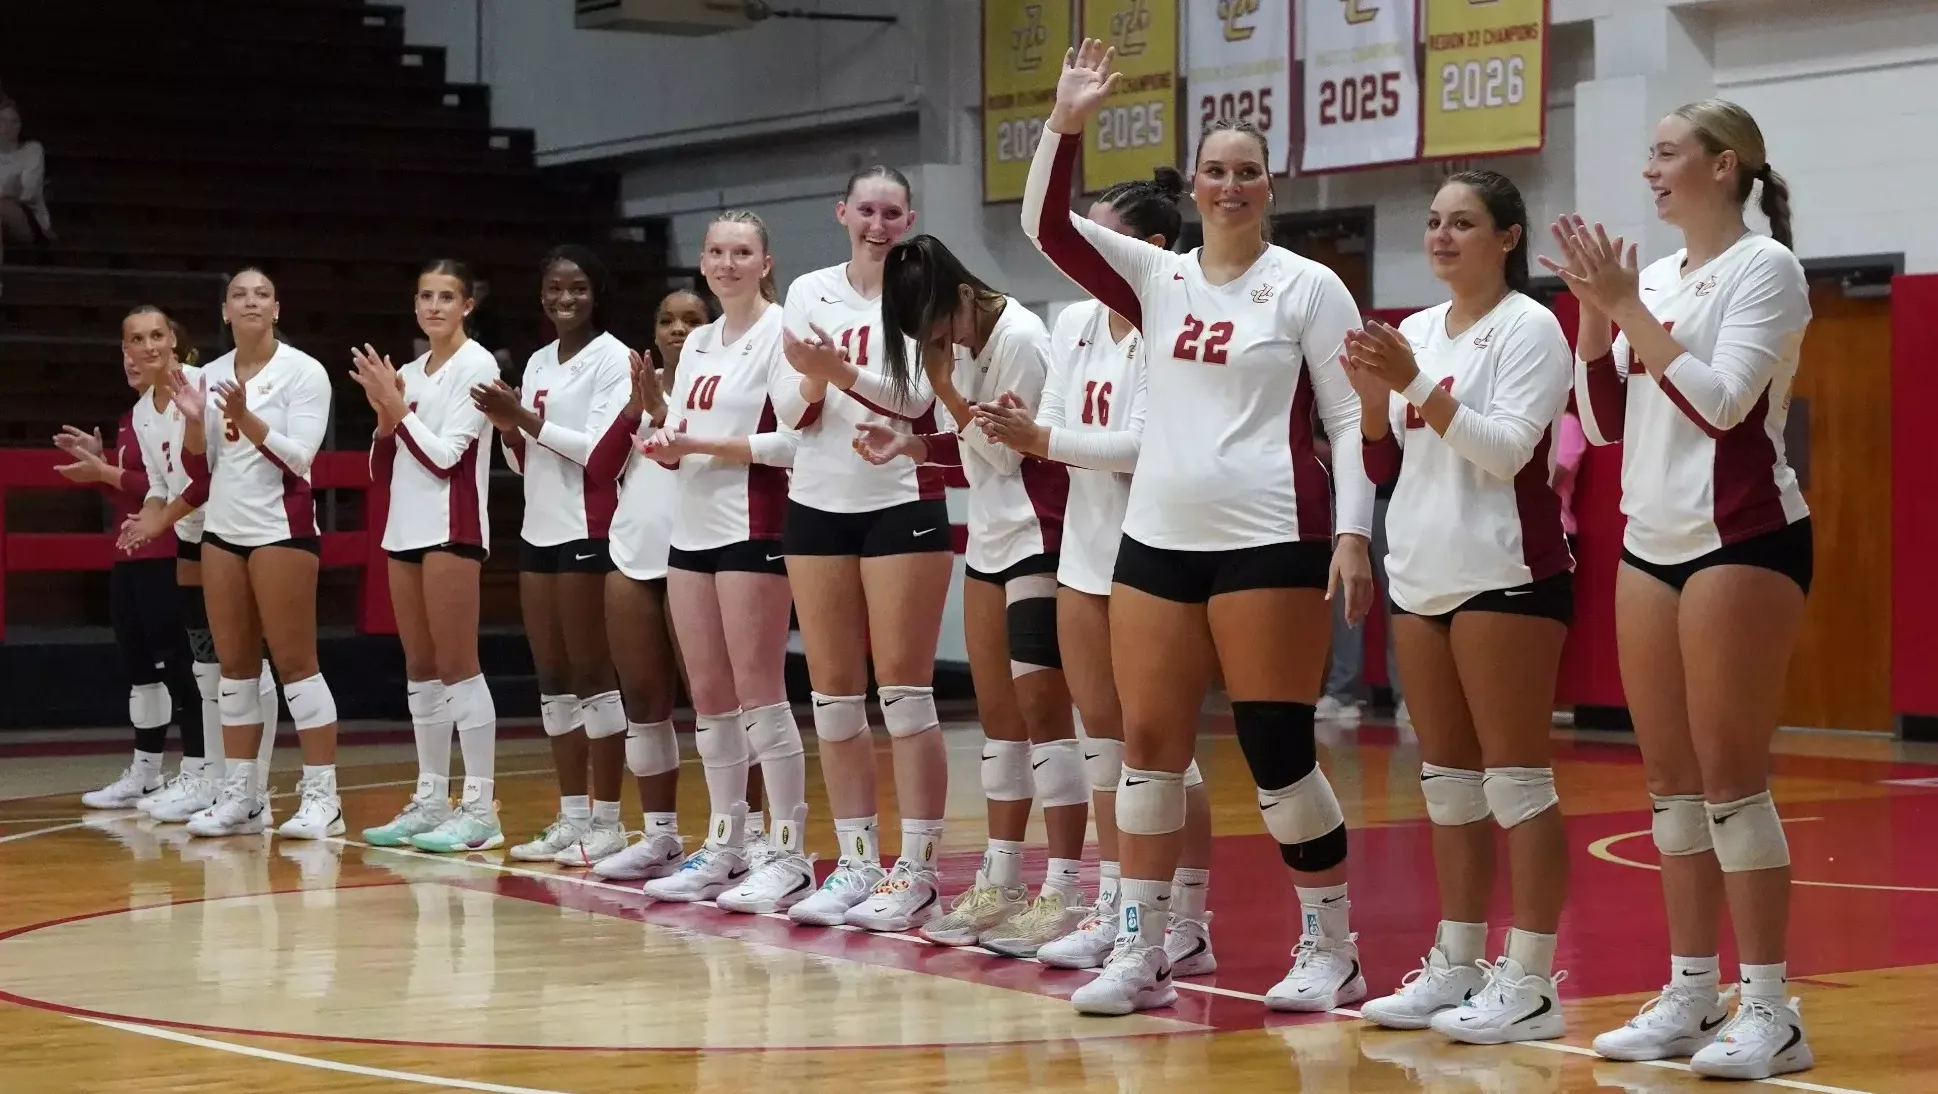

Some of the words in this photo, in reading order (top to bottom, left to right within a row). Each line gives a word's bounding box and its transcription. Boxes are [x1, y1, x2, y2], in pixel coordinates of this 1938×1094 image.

[1319, 71, 1401, 126] 2025
[1441, 55, 1525, 112] 2026
[997, 117, 1046, 162] 202
[1097, 102, 1165, 152] 2025
[841, 325, 871, 366] 11
[1173, 313, 1235, 365] 22
[533, 389, 549, 420] 5
[686, 375, 722, 410] 10
[1081, 380, 1112, 427] 16
